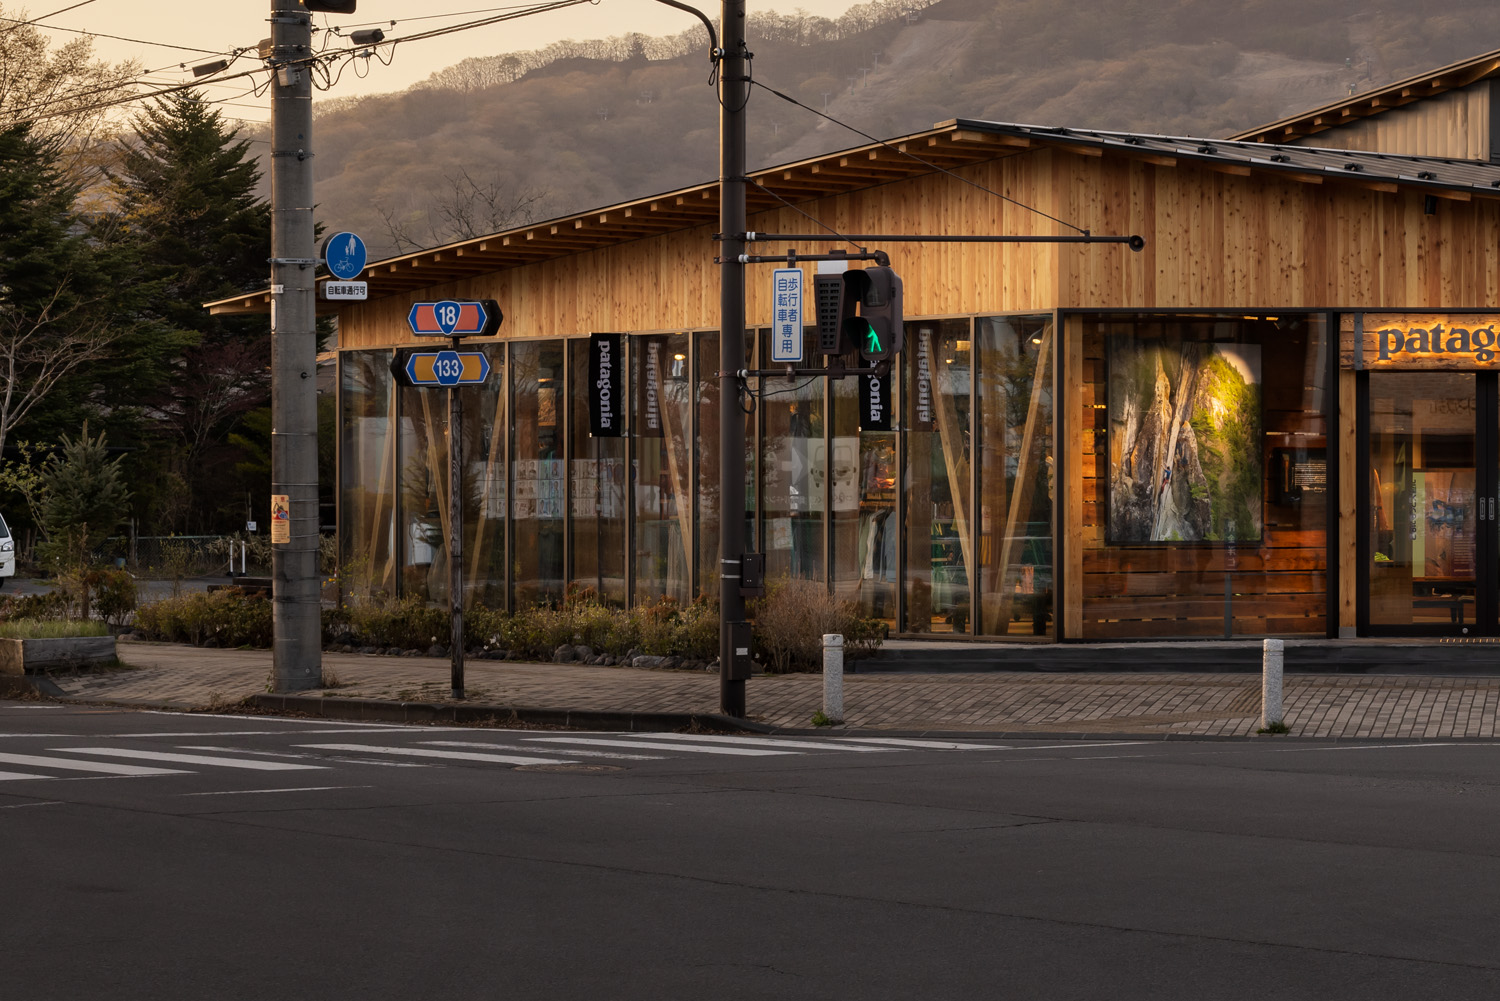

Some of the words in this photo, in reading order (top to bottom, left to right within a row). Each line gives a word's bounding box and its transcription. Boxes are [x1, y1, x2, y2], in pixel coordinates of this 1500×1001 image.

[328, 285, 366, 296] 自転車通行可
[777, 278, 788, 323] 自転車
[788, 277, 798, 323] 歩行者
[439, 306, 456, 326] 18
[781, 324, 793, 354] 専用
[436, 359, 460, 377] 133
[596, 340, 613, 429] patagonia
